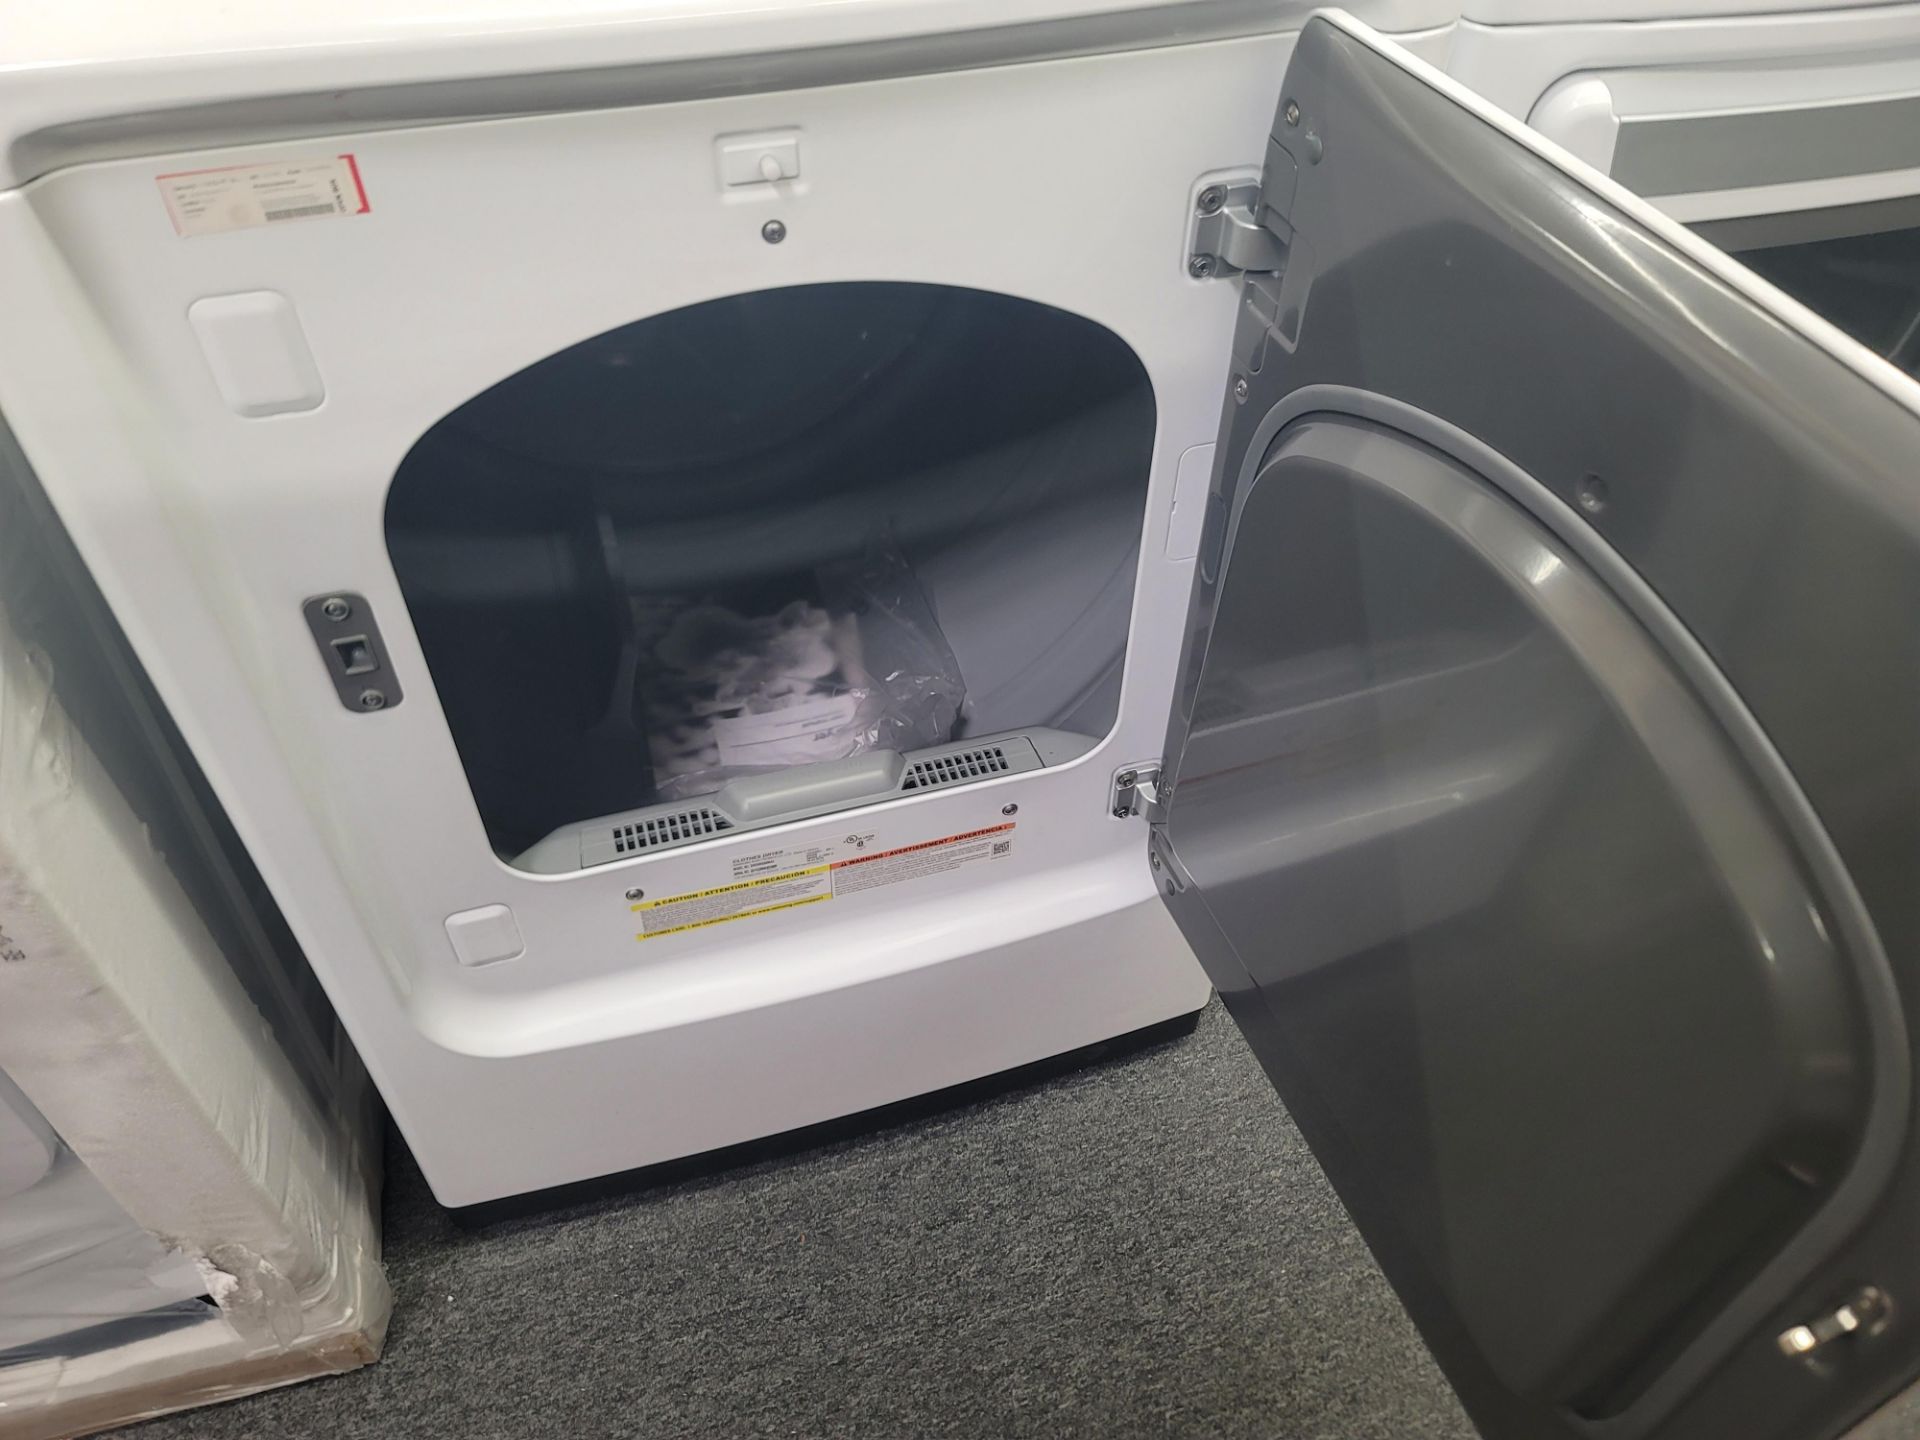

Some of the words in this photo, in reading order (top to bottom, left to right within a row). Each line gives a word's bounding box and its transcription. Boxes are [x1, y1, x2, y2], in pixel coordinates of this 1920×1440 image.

[848, 853, 884, 864] WARNING
[889, 838, 948, 856] AVERTISSEMENT
[953, 826, 1003, 841] ADVERTENCIA
[662, 892, 698, 905] CAUTION
[704, 882, 749, 897] ATTENTION
